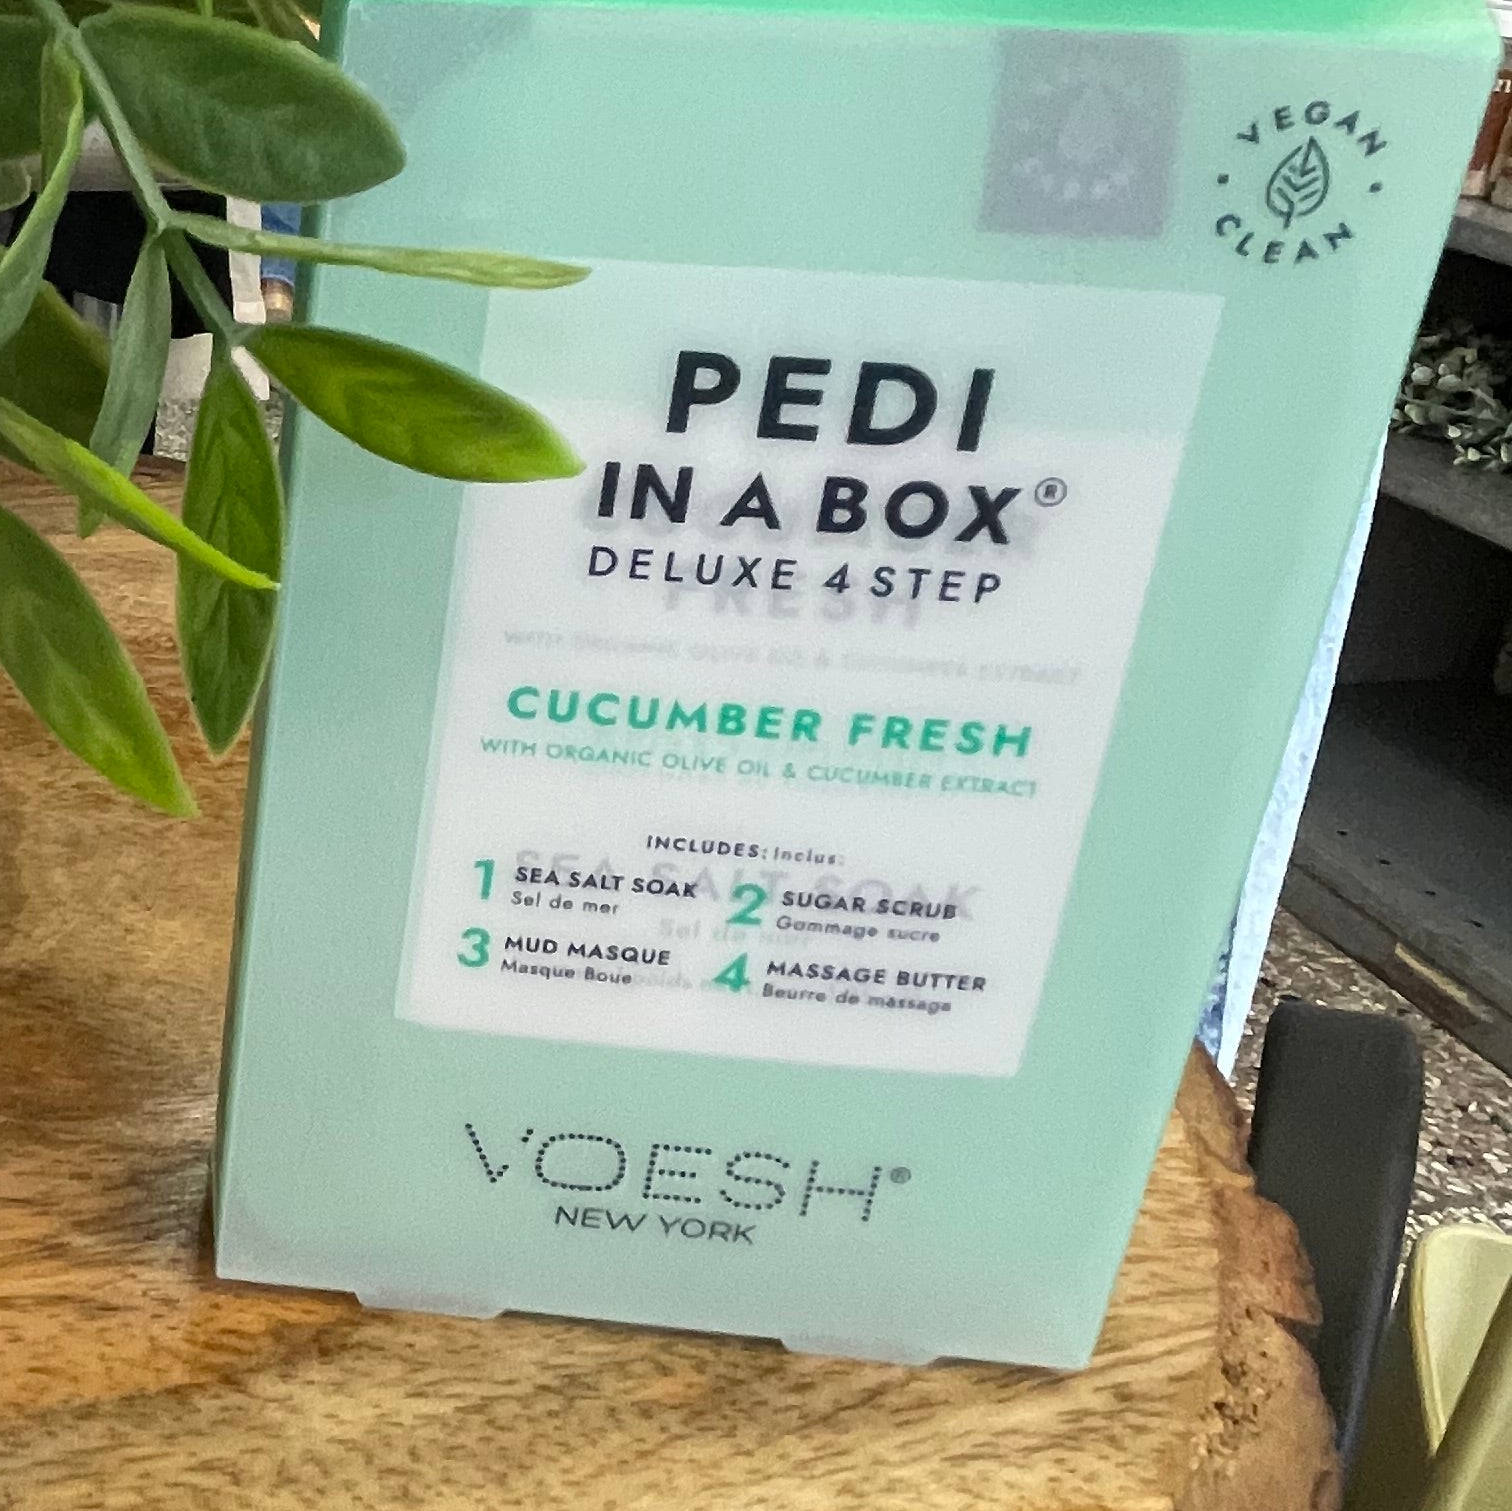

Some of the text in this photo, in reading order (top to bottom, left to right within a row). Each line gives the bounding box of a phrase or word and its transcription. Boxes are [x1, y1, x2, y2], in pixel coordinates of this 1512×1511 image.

[1237, 100, 1388, 157] VEGAN
[1216, 214, 1354, 264] CLEAN
[665, 349, 997, 452] PEDI
[597, 461, 694, 524] IN
[719, 471, 782, 531] A
[587, 544, 1003, 604] DELUXE 4 STEP
[507, 685, 1033, 758] CUCUMBER FRESH
[480, 737, 1037, 798] WITH ORGANIC OLIVE OIL & CUCUMBER EXTRACT
[646, 835, 768, 859] INCLUDES:
[474, 858, 496, 901] 1
[515, 866, 698, 899] SEA SALT SOAK
[510, 890, 621, 915] Sel de mer
[725, 882, 768, 925] 2
[781, 890, 958, 920] SUGAR SCRUB
[457, 927, 490, 968] 3
[504, 936, 671, 966] MUD MASQUE
[500, 958, 576, 980] Masque
[584, 966, 633, 985] Boue
[711, 951, 750, 992] 4
[766, 960, 987, 992] MASSAGE BUTTER
[762, 982, 952, 1015] Beurre de massage
[554, 1205, 758, 1245] NEW YORK
